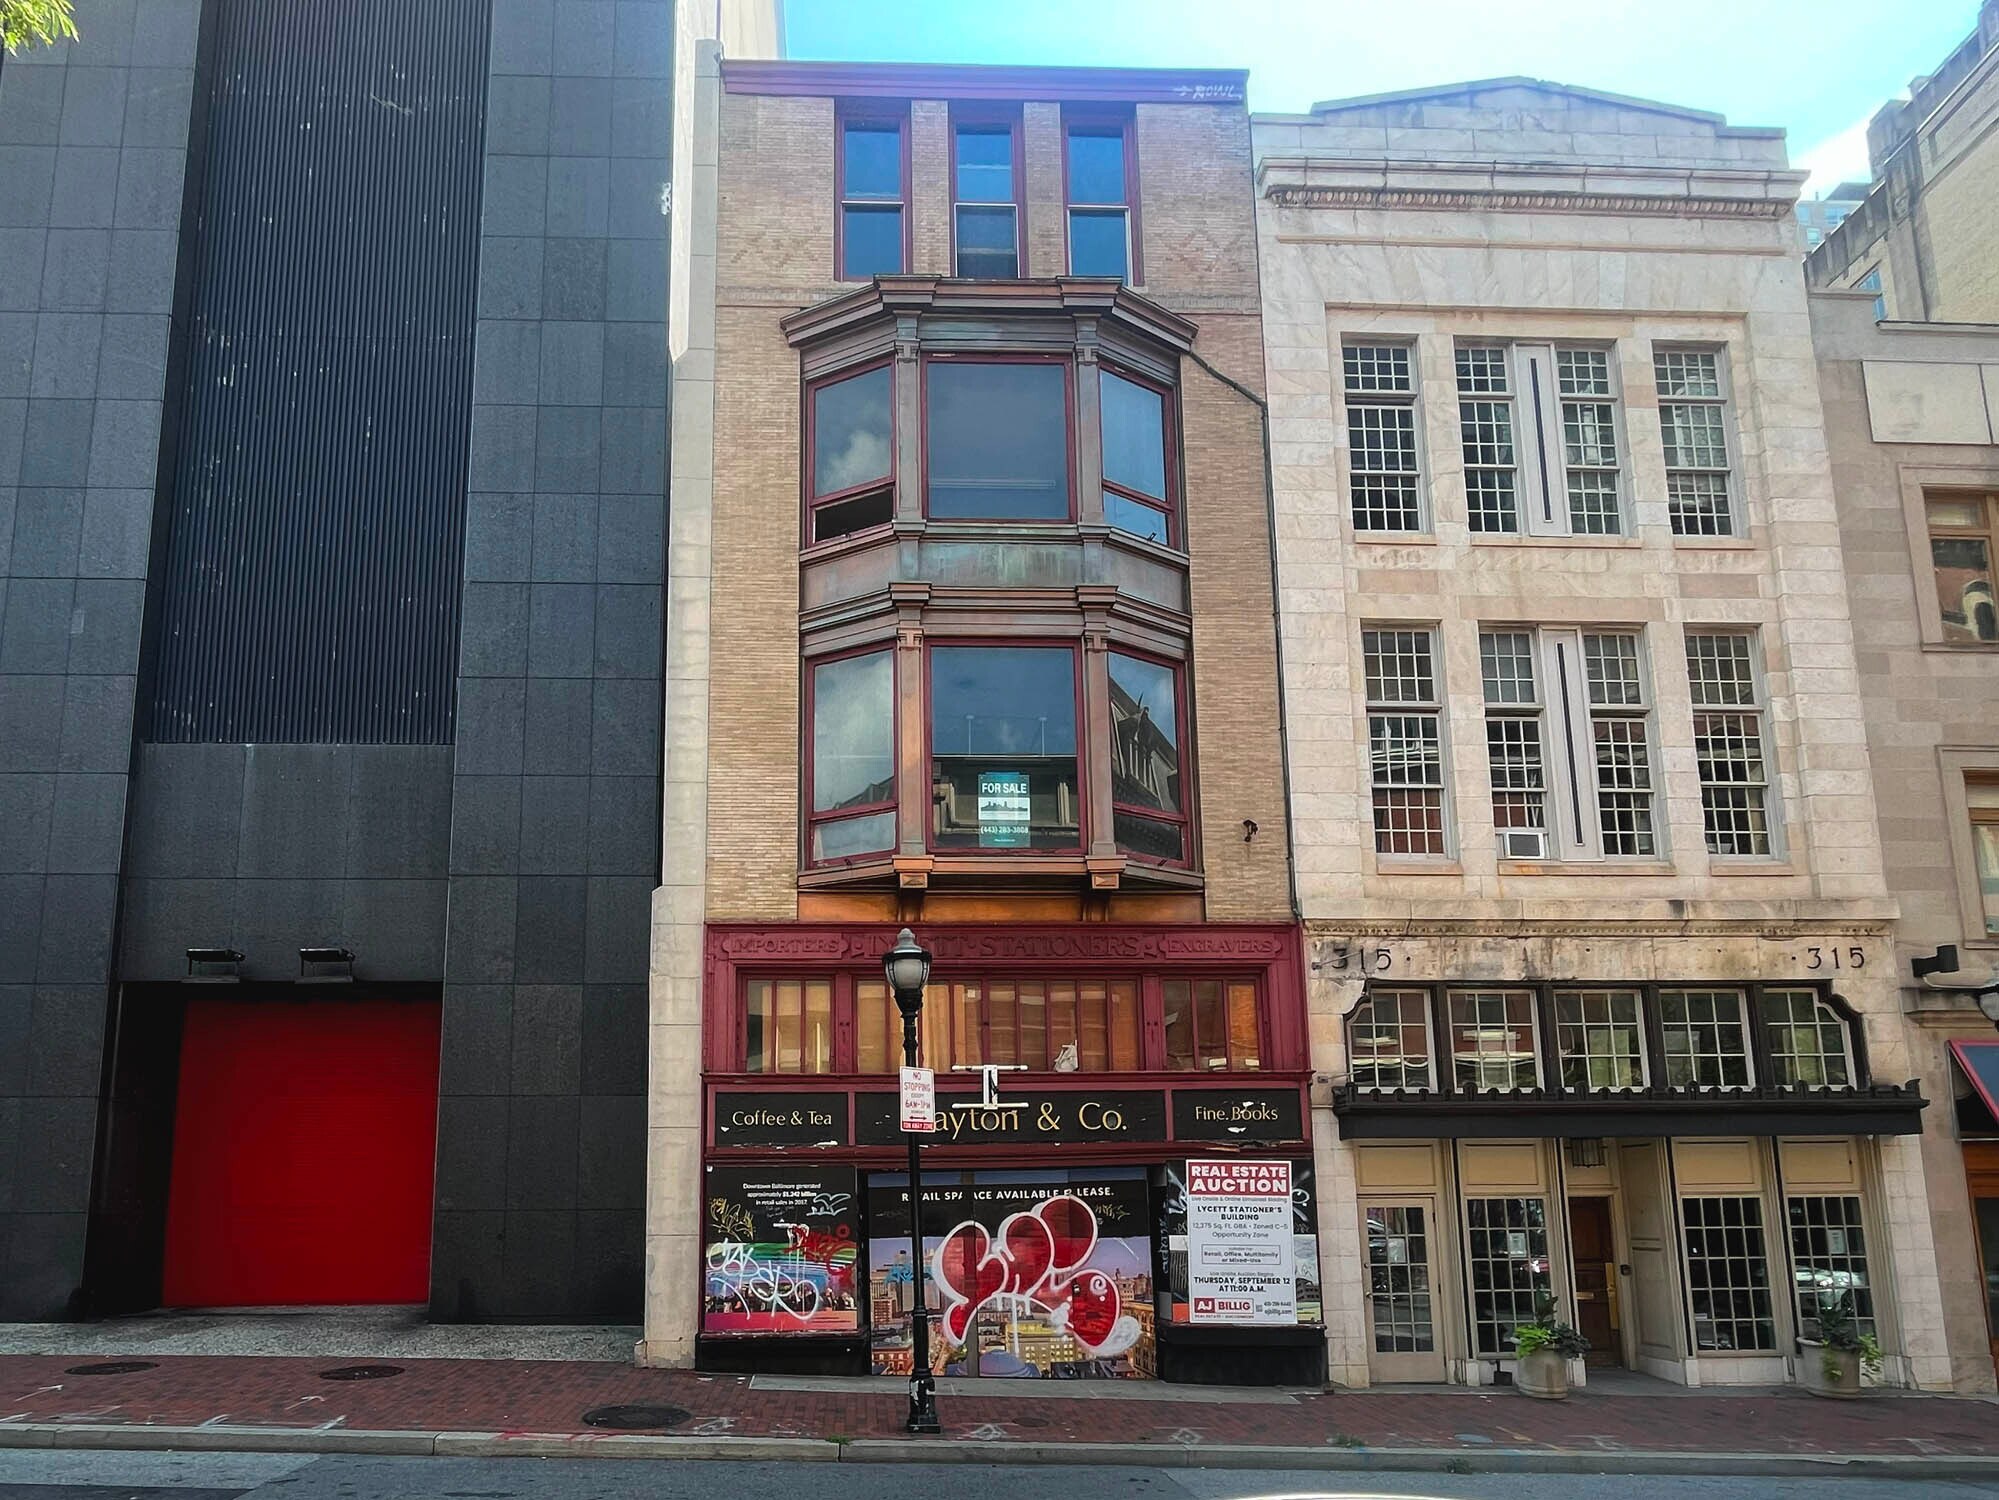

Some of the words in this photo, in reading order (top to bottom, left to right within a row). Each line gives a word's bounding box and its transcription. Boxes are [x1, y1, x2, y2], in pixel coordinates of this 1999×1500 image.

[982, 783, 1001, 793] FOR
[1003, 783, 1027, 793] SALE
[734, 936, 841, 953] IMPORTERS
[869, 936, 968, 957] LYETT
[978, 936, 1141, 957] STATIONERS
[1166, 938, 1275, 953] ENGRAVERS
[1331, 947, 1392, 970] 315
[1807, 946, 1865, 970] 315
[912, 1071, 922, 1081] NO
[904, 1082, 931, 1092] STOPPING
[732, 1110, 786, 1126] Coffee
[790, 1110, 804, 1126] &
[807, 1110, 833, 1125] Tea
[1232, 1105, 1278, 1120] Books
[935, 1108, 1019, 1139] ayton
[1037, 1102, 1061, 1131] &
[1078, 1102, 1127, 1131] Co.
[1191, 1166, 1228, 1177] REAL
[1231, 1166, 1287, 1178] ESTATE
[1191, 1179, 1287, 1193] AUCTION
[902, 1191, 941, 1202] RAIL
[996, 1188, 1059, 1200] AVAILABLE
[1077, 1186, 1115, 1197] LEASE.
[1244, 1251, 1278, 1259] Multifamily
[1194, 1276, 1237, 1285] THURSDAY,
[1238, 1277, 1280, 1285] SEPTEMBER
[1197, 1301, 1212, 1310] AJ
[1218, 1302, 1251, 1311] BILLIG
